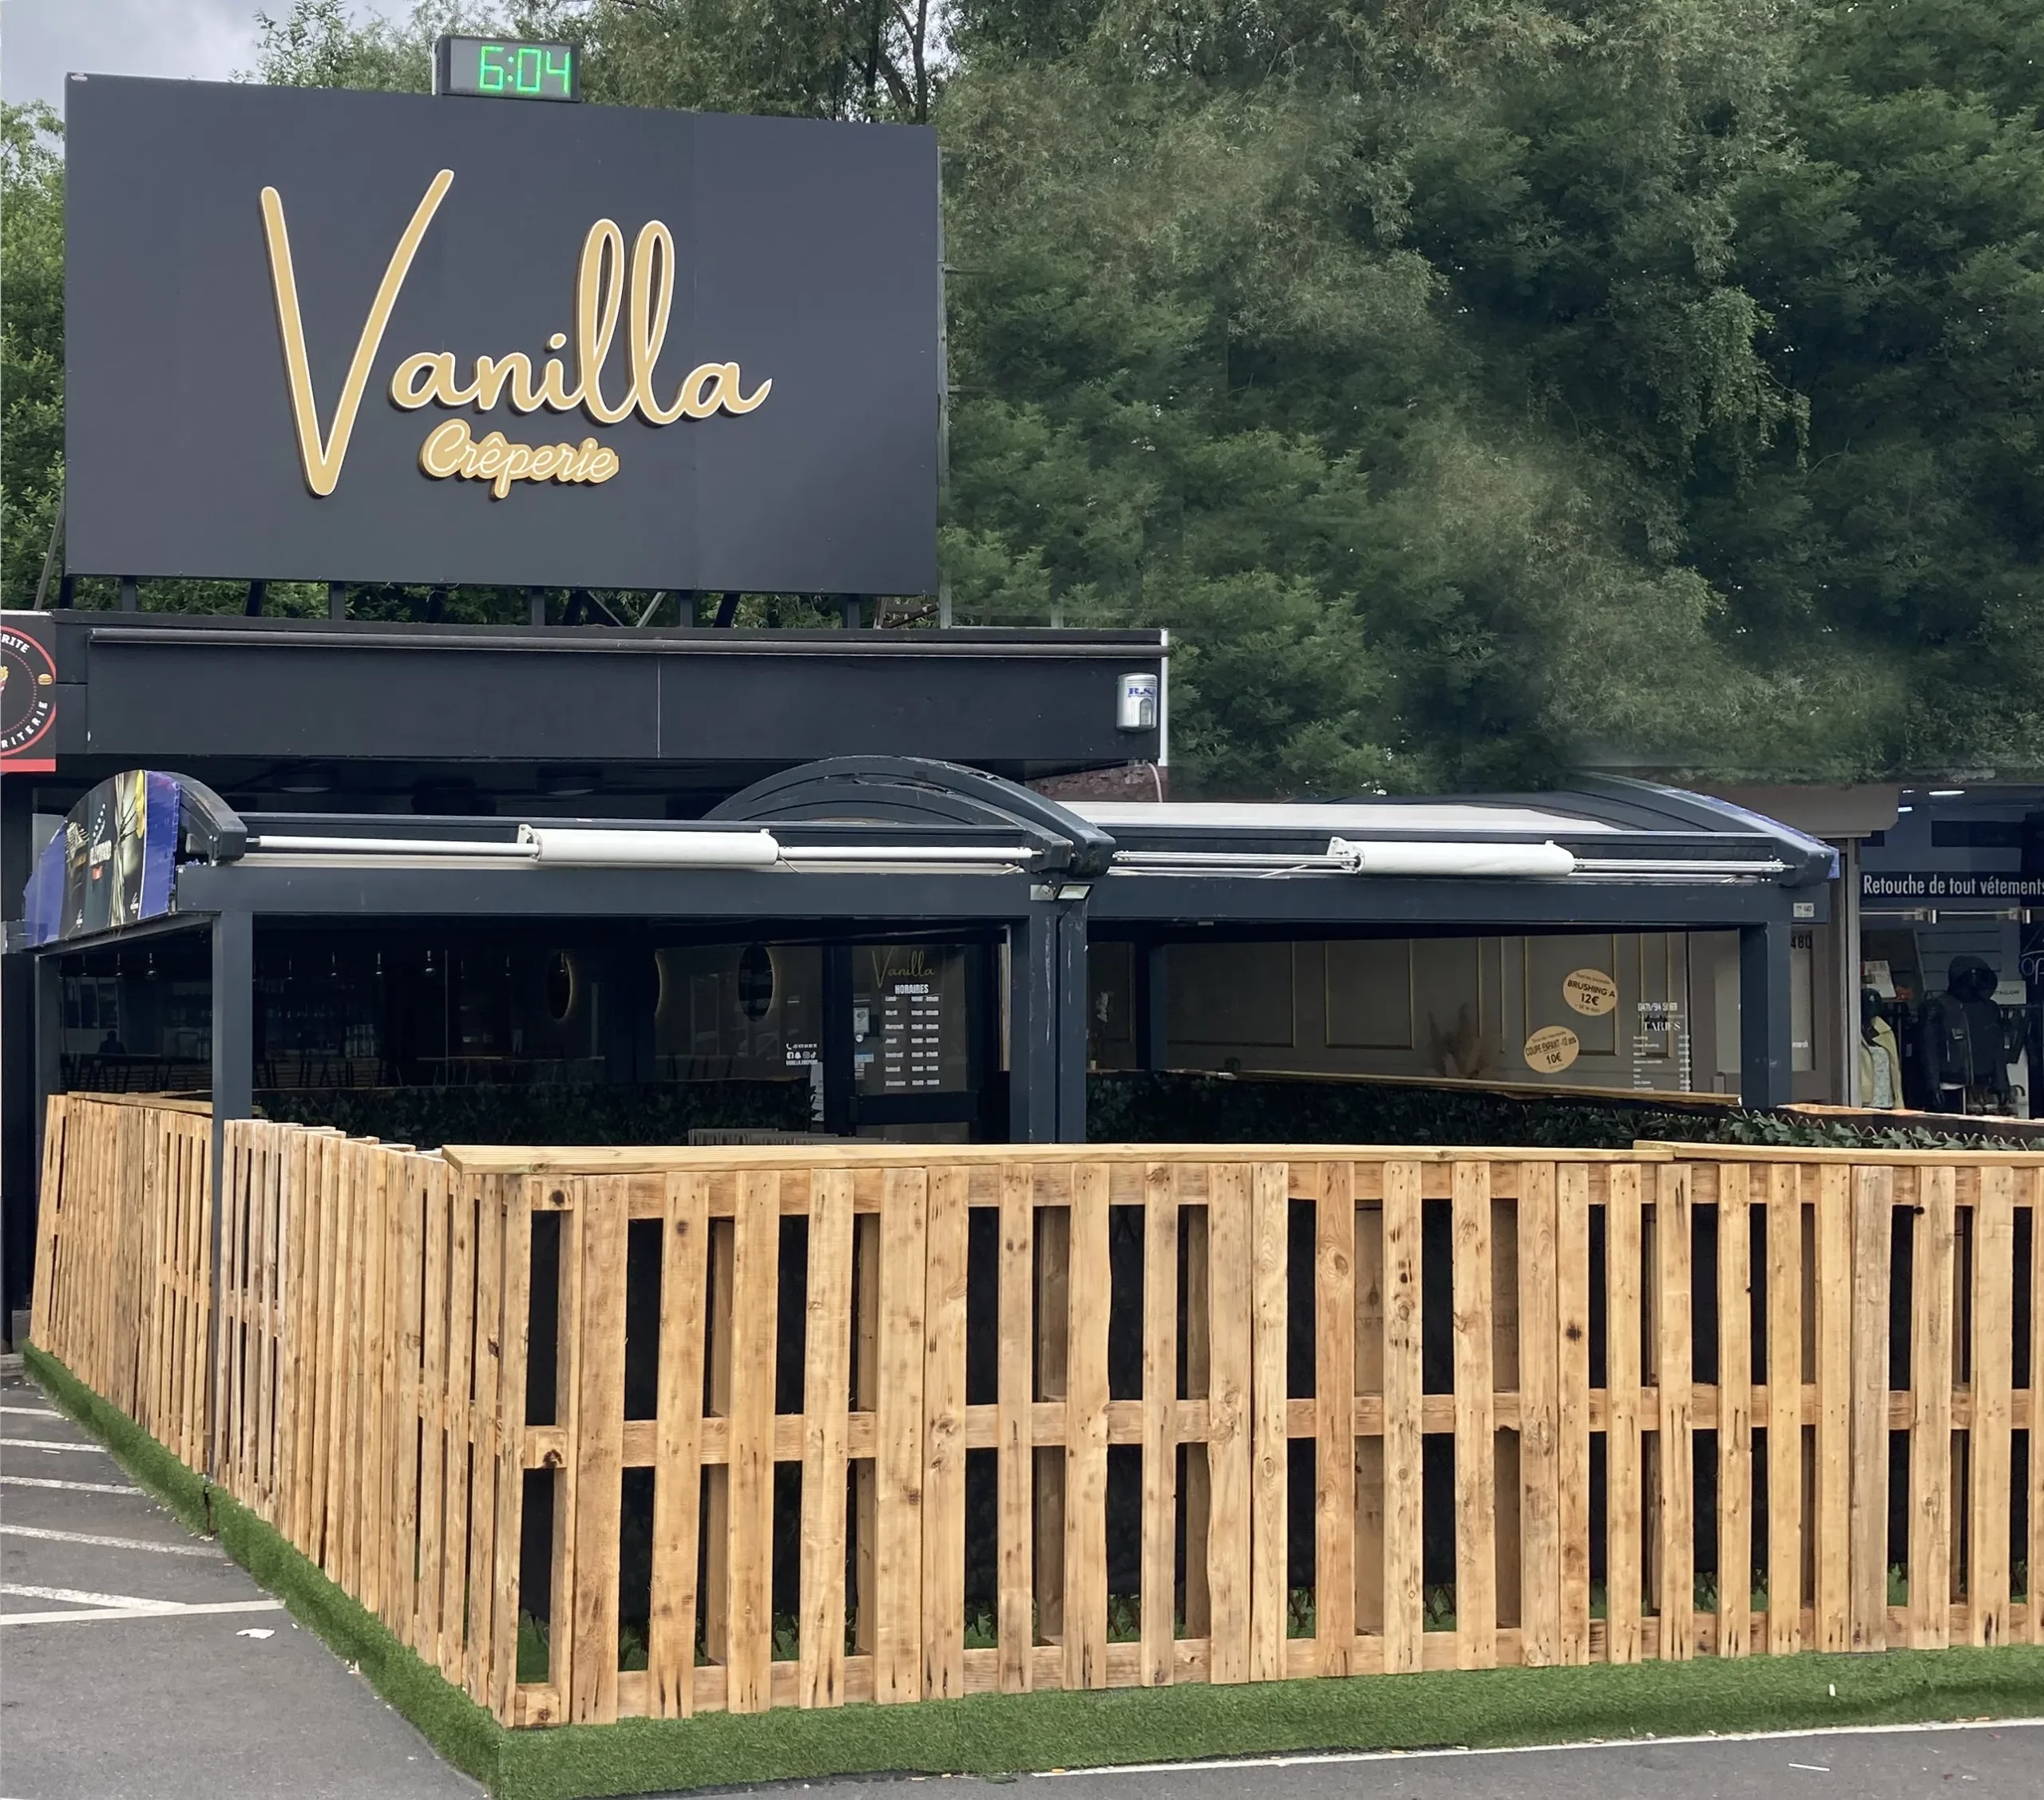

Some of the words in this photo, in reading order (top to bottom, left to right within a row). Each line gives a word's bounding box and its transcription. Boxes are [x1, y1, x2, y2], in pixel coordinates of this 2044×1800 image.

[479, 45, 572, 94] 6:04
[260, 168, 772, 496] Vanilla
[418, 419, 620, 499] Crêperie
[0, 632, 30, 654] RITE
[1863, 874, 1925, 895] Retouche
[1929, 874, 1946, 895] de
[1950, 878, 1976, 895] tout
[871, 945, 936, 988] Vanilla
[894, 983, 929, 995] HORAIRES
[1567, 979, 1607, 995] BRUSHING
[1581, 992, 1600, 1006] 12€
[1546, 1051, 1562, 1065] 10€
